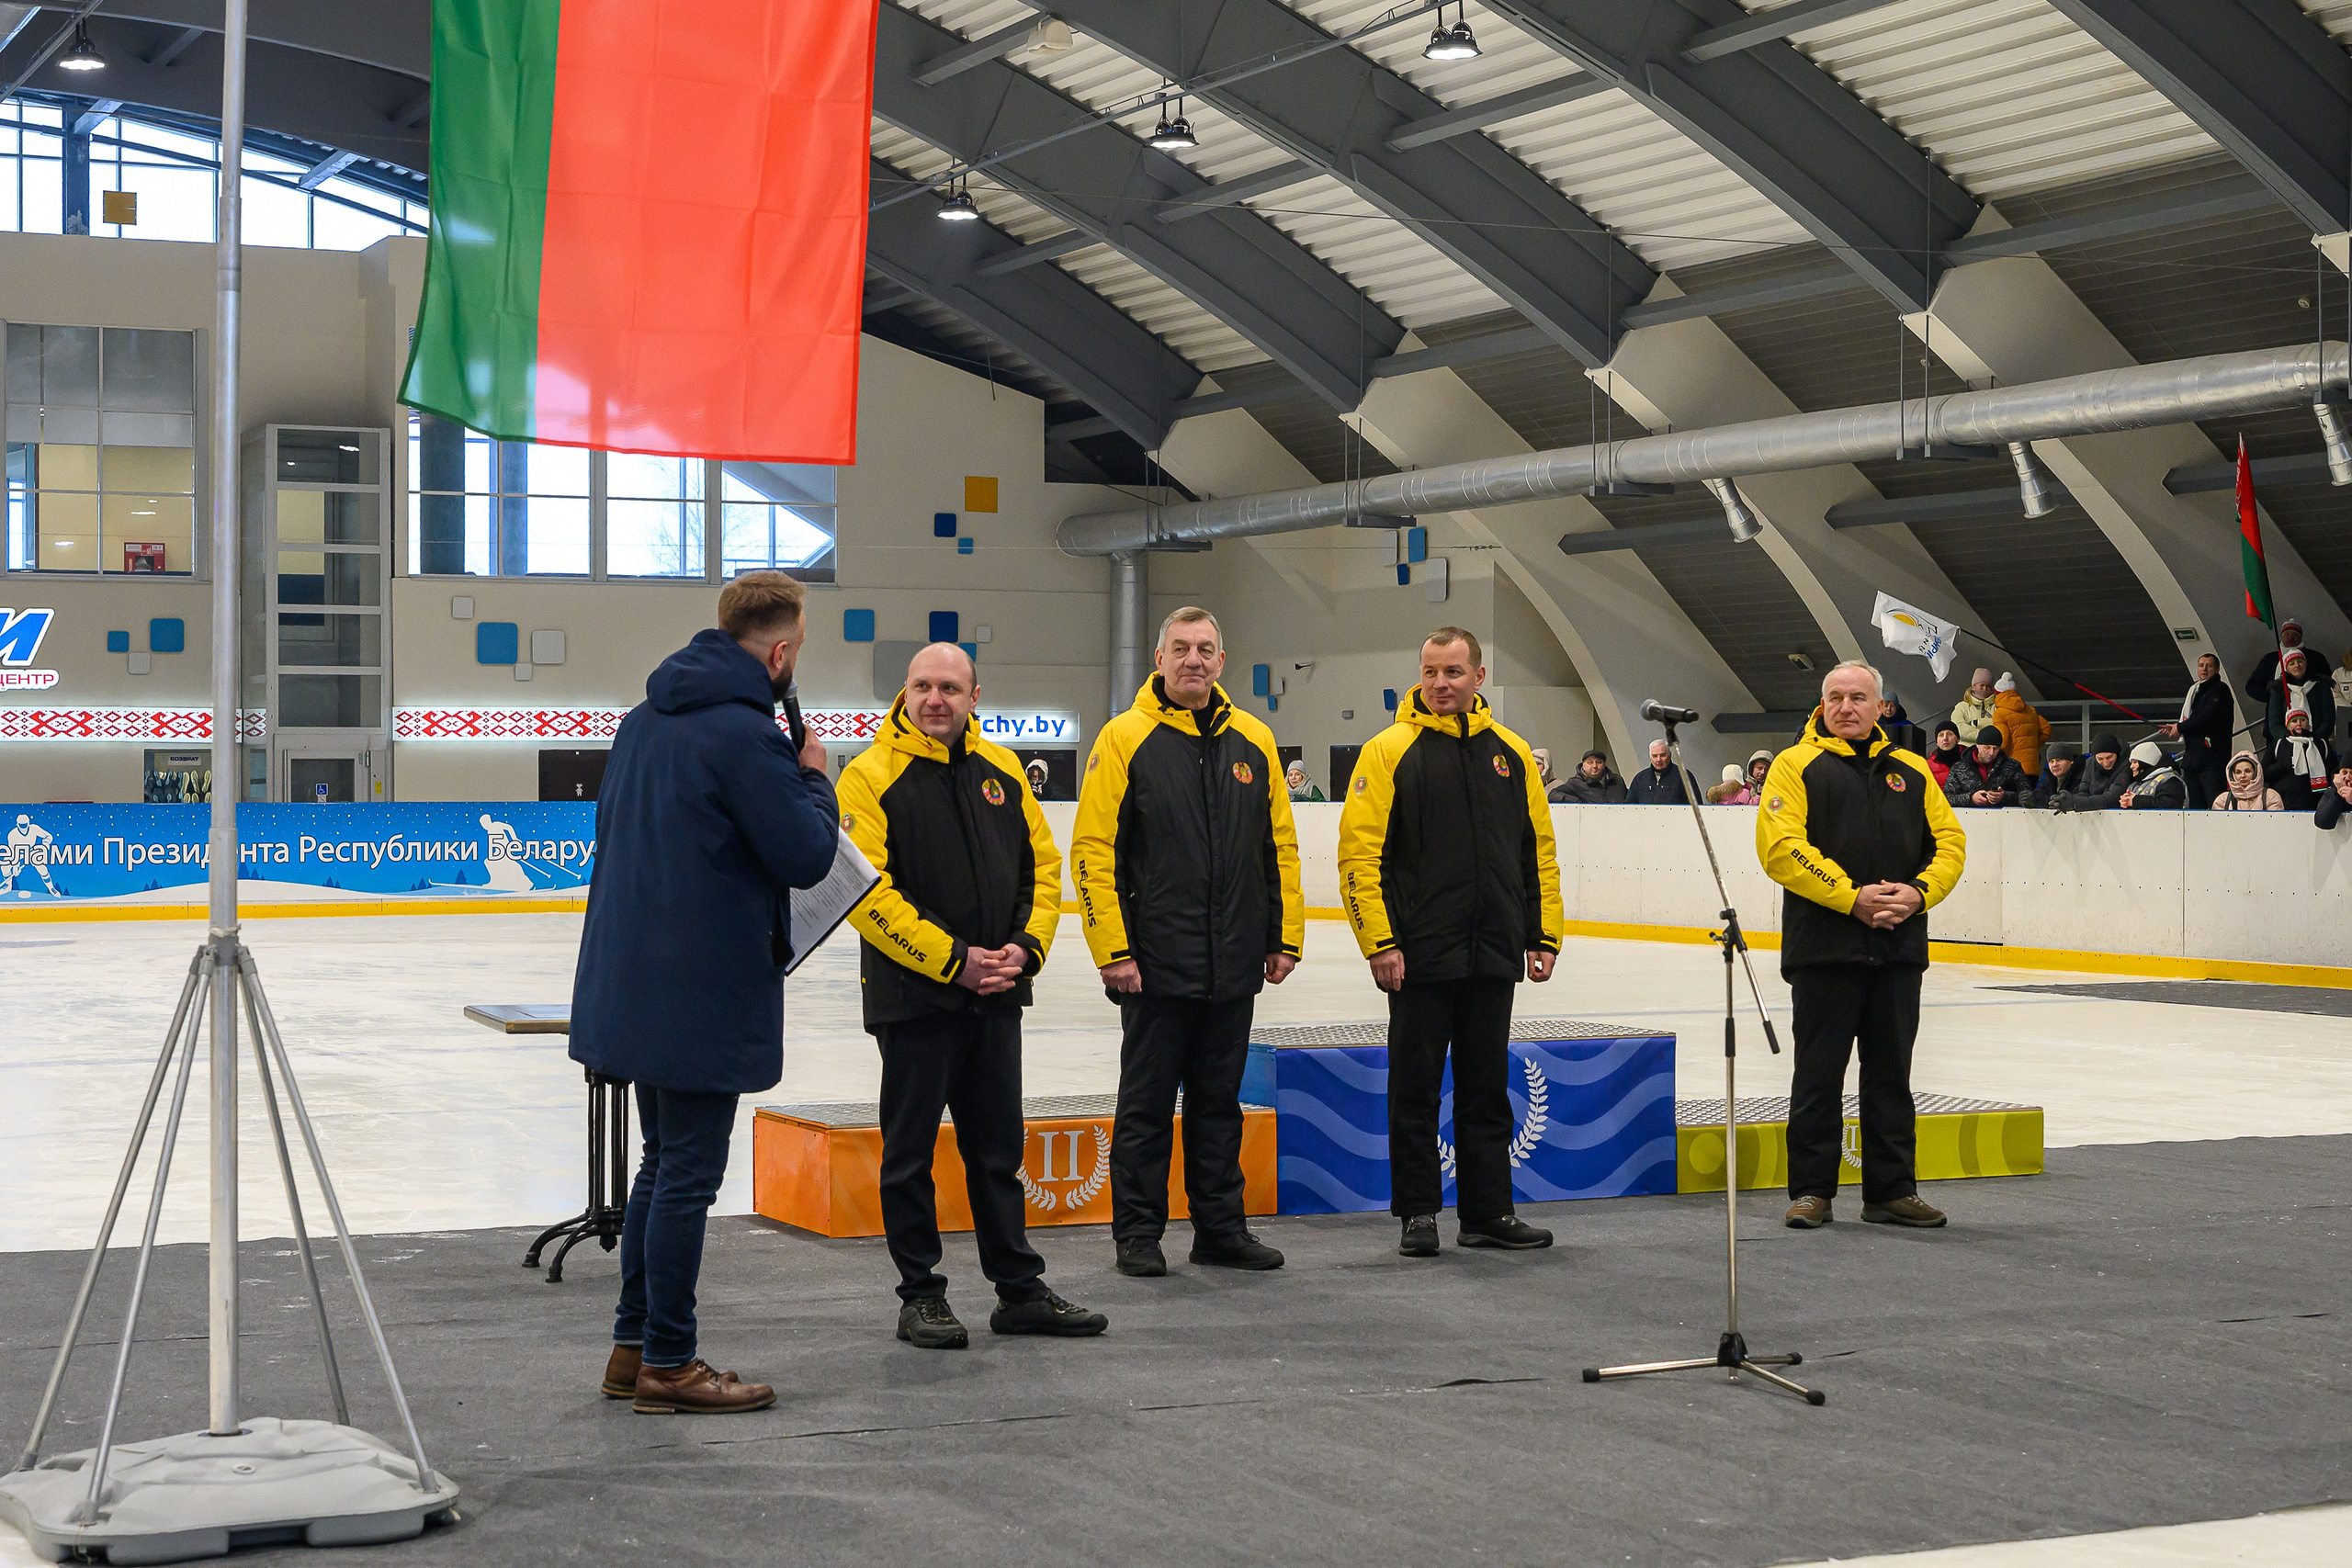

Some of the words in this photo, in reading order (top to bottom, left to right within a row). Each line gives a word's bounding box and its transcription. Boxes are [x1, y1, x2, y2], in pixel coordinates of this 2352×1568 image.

[977, 715, 1067, 738] chy.by
[102, 837, 290, 872] Презинта
[299, 833, 479, 870] Республики
[486, 833, 597, 868] Белару
[1791, 848, 1838, 888] BELARUS
[1079, 859, 1097, 928] BELARUS
[1347, 872, 1364, 931] BELARUS
[868, 908, 928, 964] BELARUS
[1037, 1130, 1085, 1182] II
